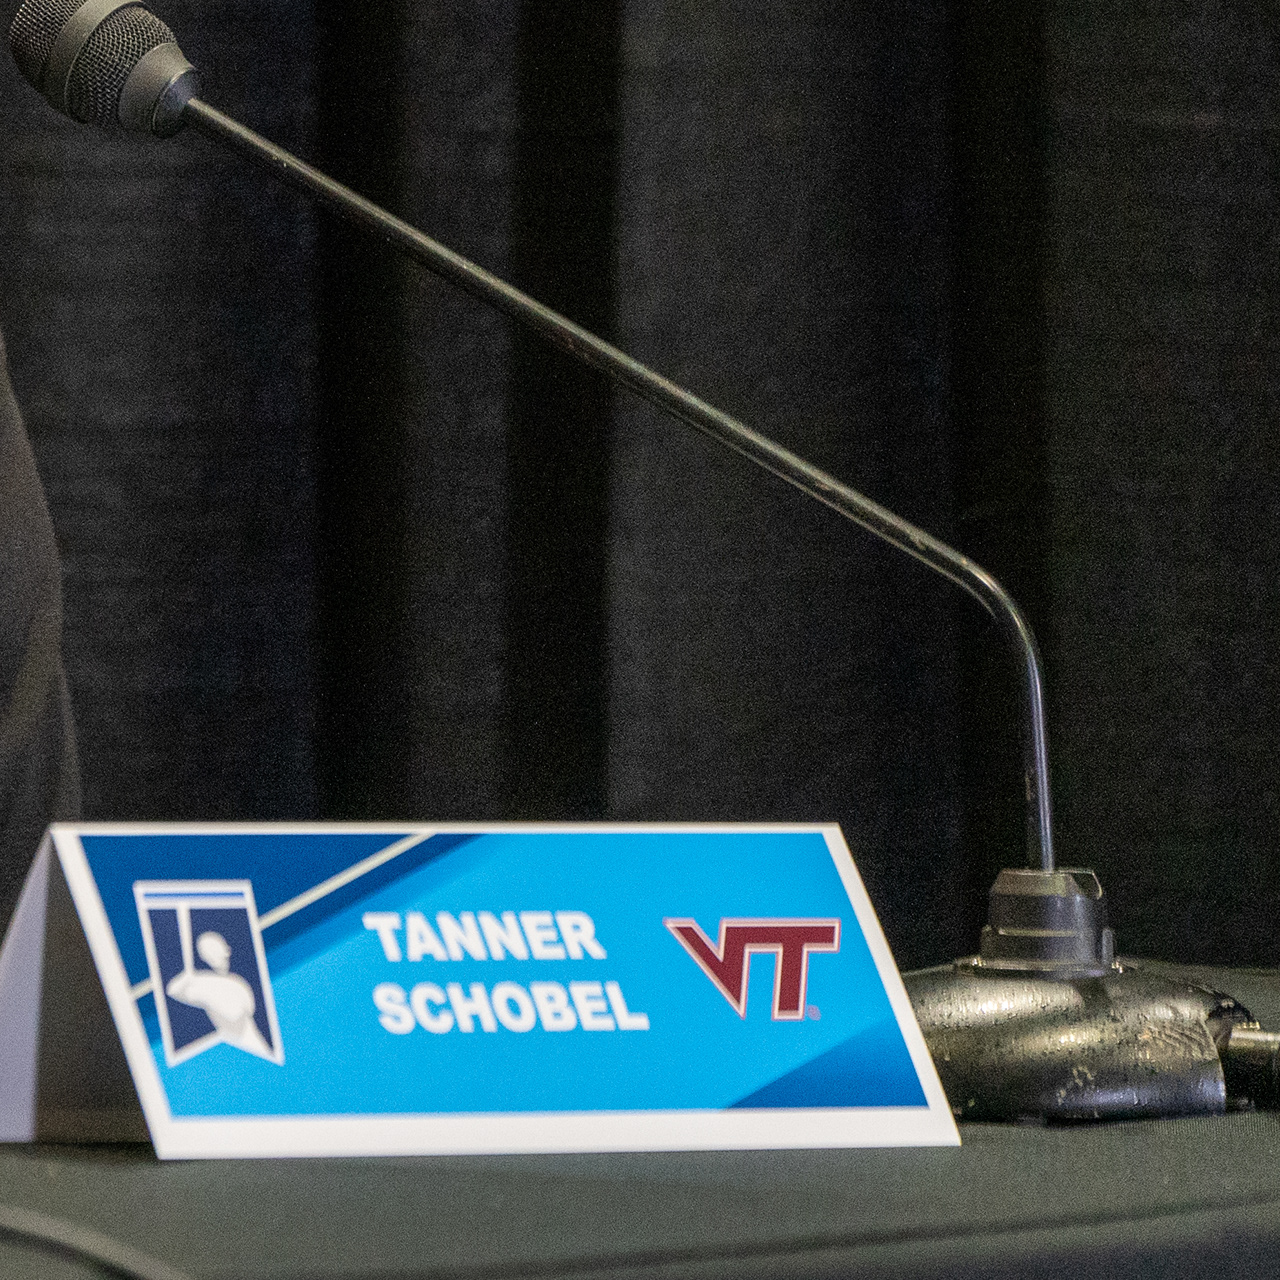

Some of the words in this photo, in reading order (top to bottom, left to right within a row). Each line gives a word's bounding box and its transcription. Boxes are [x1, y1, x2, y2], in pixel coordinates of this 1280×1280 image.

[362, 910, 608, 962] TANNER
[662, 917, 841, 1022] VT
[372, 980, 650, 1035] SCHOBEL
